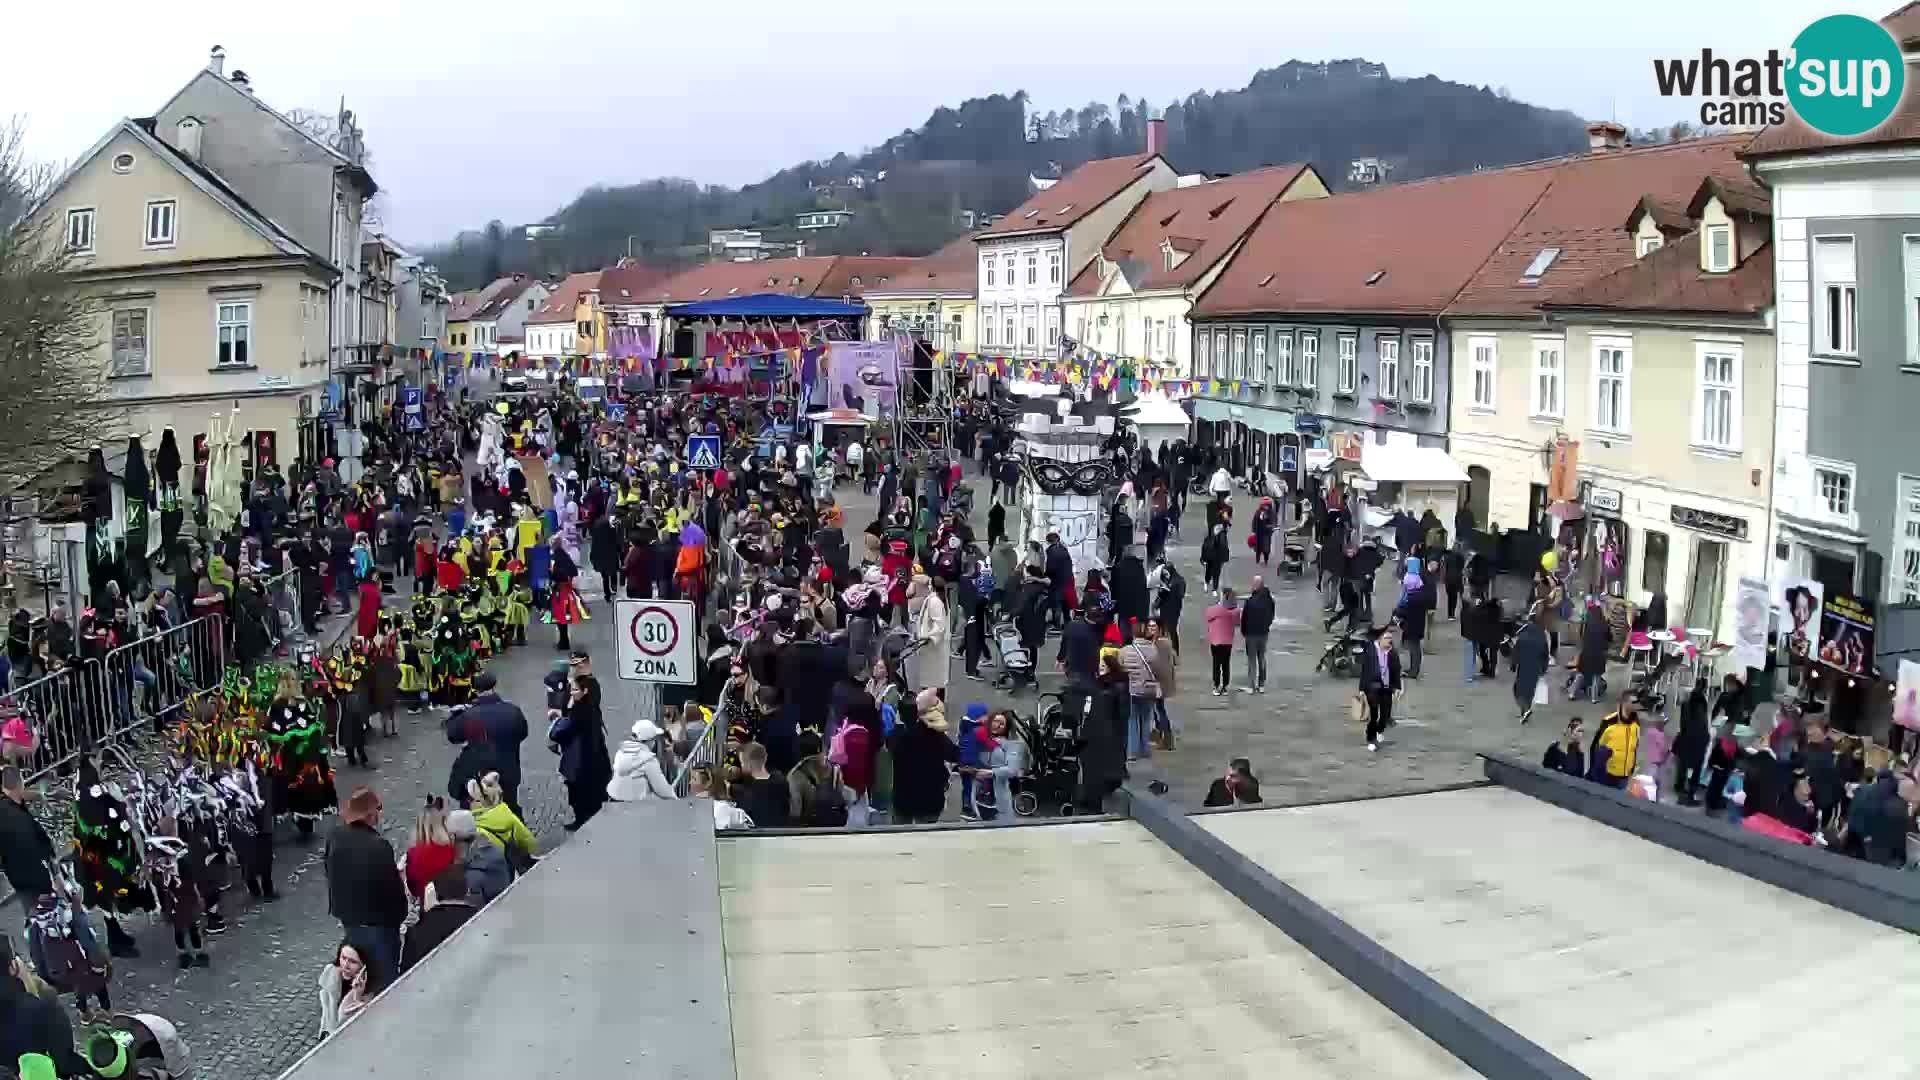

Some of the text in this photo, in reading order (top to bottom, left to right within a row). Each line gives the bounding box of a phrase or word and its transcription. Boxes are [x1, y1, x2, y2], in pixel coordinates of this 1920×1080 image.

[408, 391, 417, 403] P
[644, 622, 667, 642] 30
[634, 660, 678, 676] ZONA
